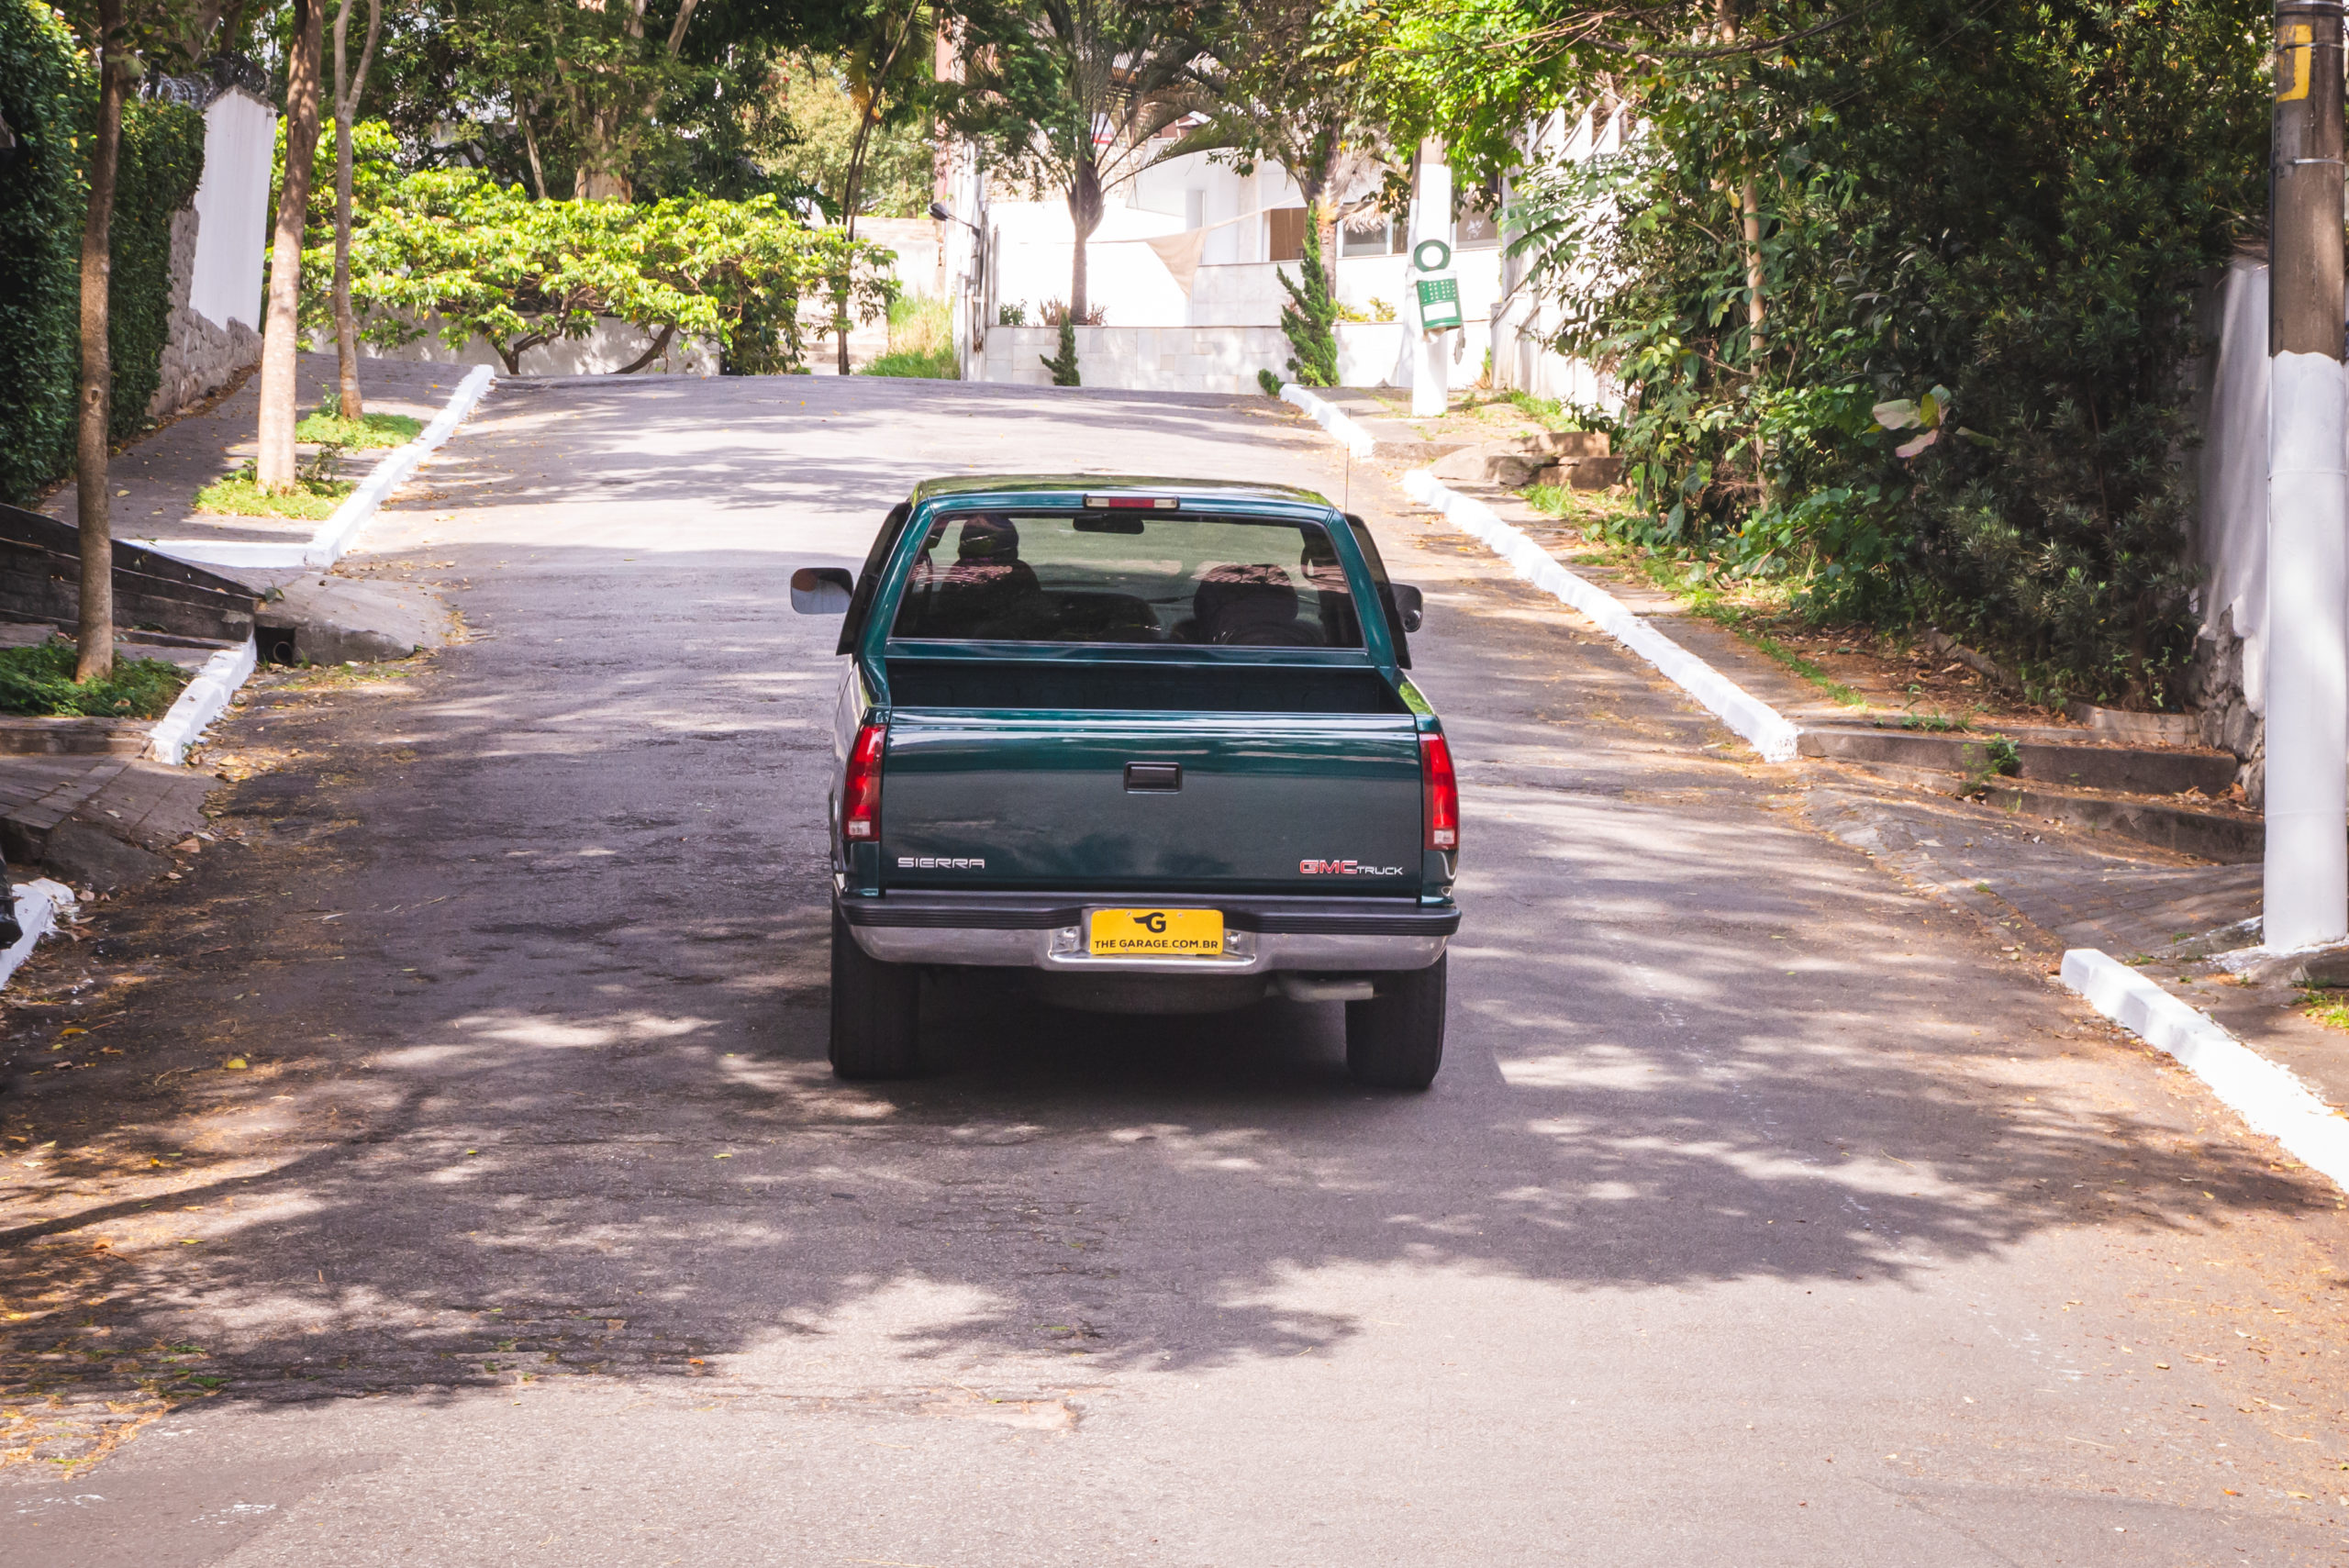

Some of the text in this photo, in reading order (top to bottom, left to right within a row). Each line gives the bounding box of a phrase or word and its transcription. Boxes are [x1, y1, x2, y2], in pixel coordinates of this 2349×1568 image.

[898, 857, 985, 869] SIERRA
[1299, 859, 1404, 875] GMC TRUCK
[1144, 912, 1166, 933] G
[1095, 939, 1219, 949] THE GARAGE.COM.BR
